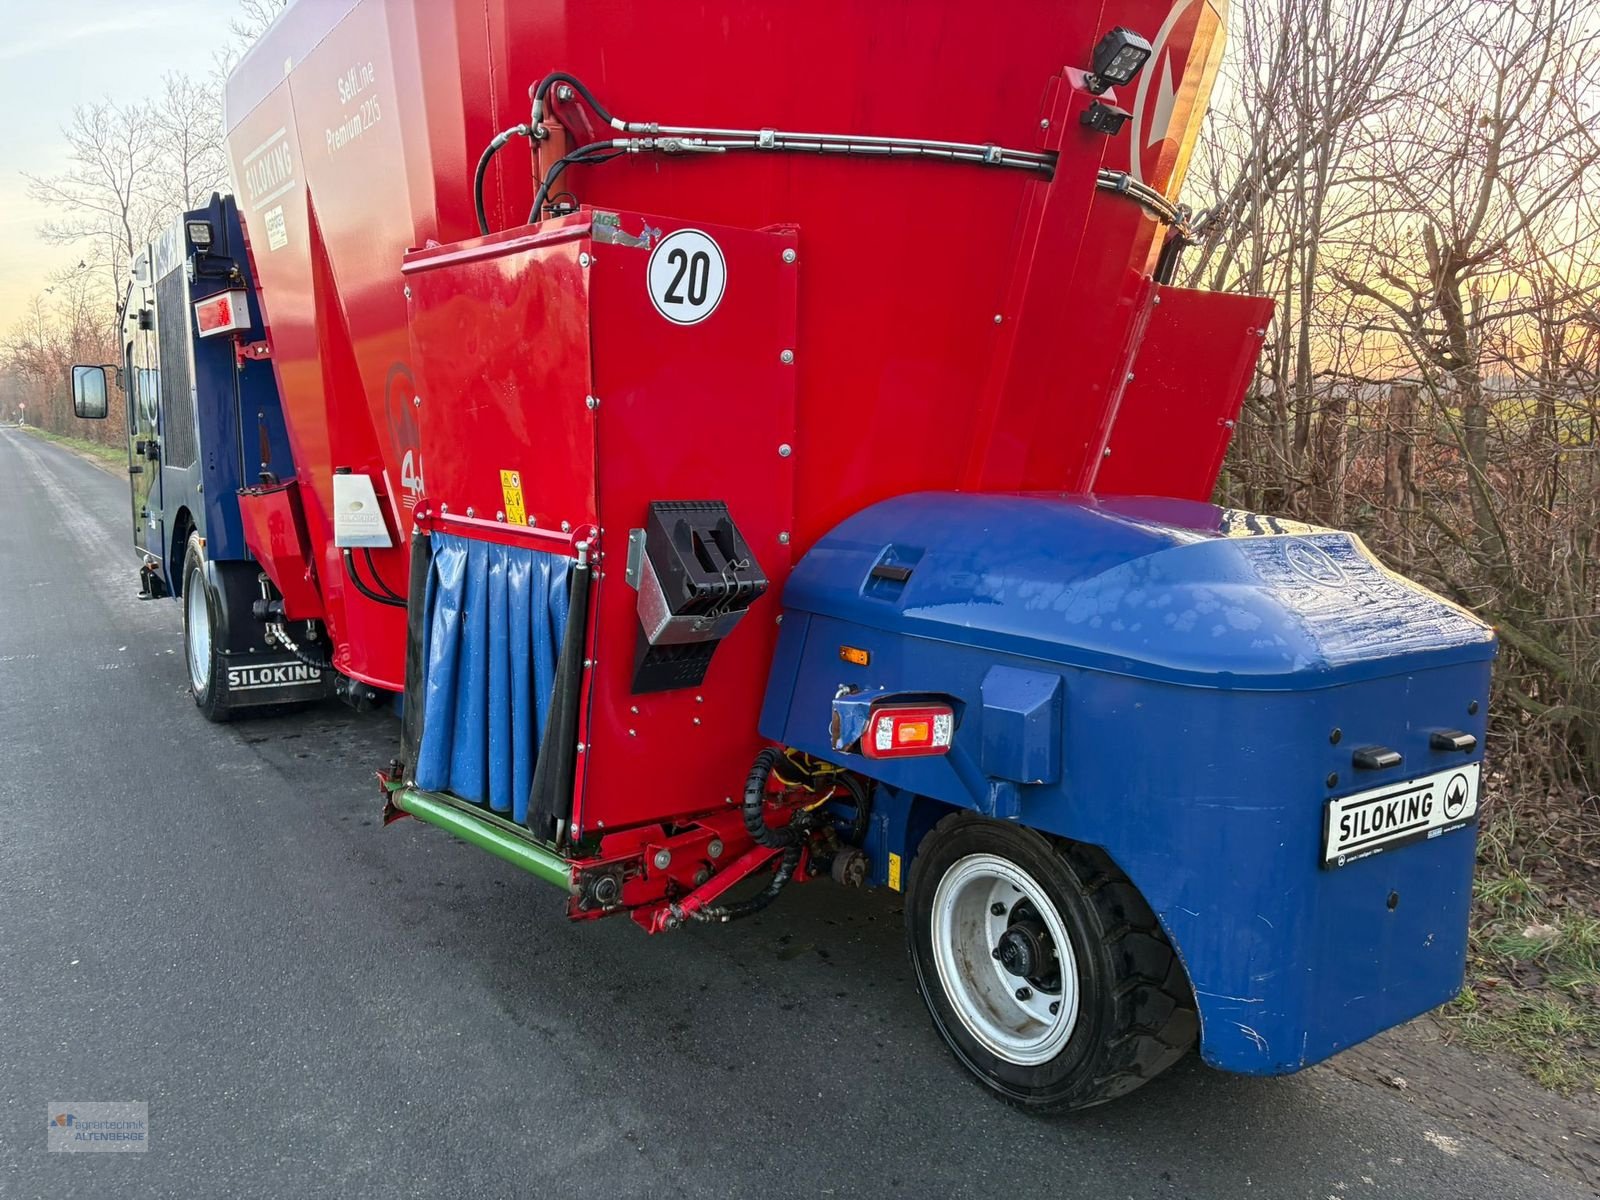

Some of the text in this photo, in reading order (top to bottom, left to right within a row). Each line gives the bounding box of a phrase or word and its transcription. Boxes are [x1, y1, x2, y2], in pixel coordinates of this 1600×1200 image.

[338, 62, 374, 104] SelfLine
[325, 94, 381, 154] Premium 2215
[245, 140, 292, 201] SILOKING
[664, 248, 710, 306] 20
[228, 665, 320, 686] SILOKING
[1339, 792, 1433, 842] SILOKING
